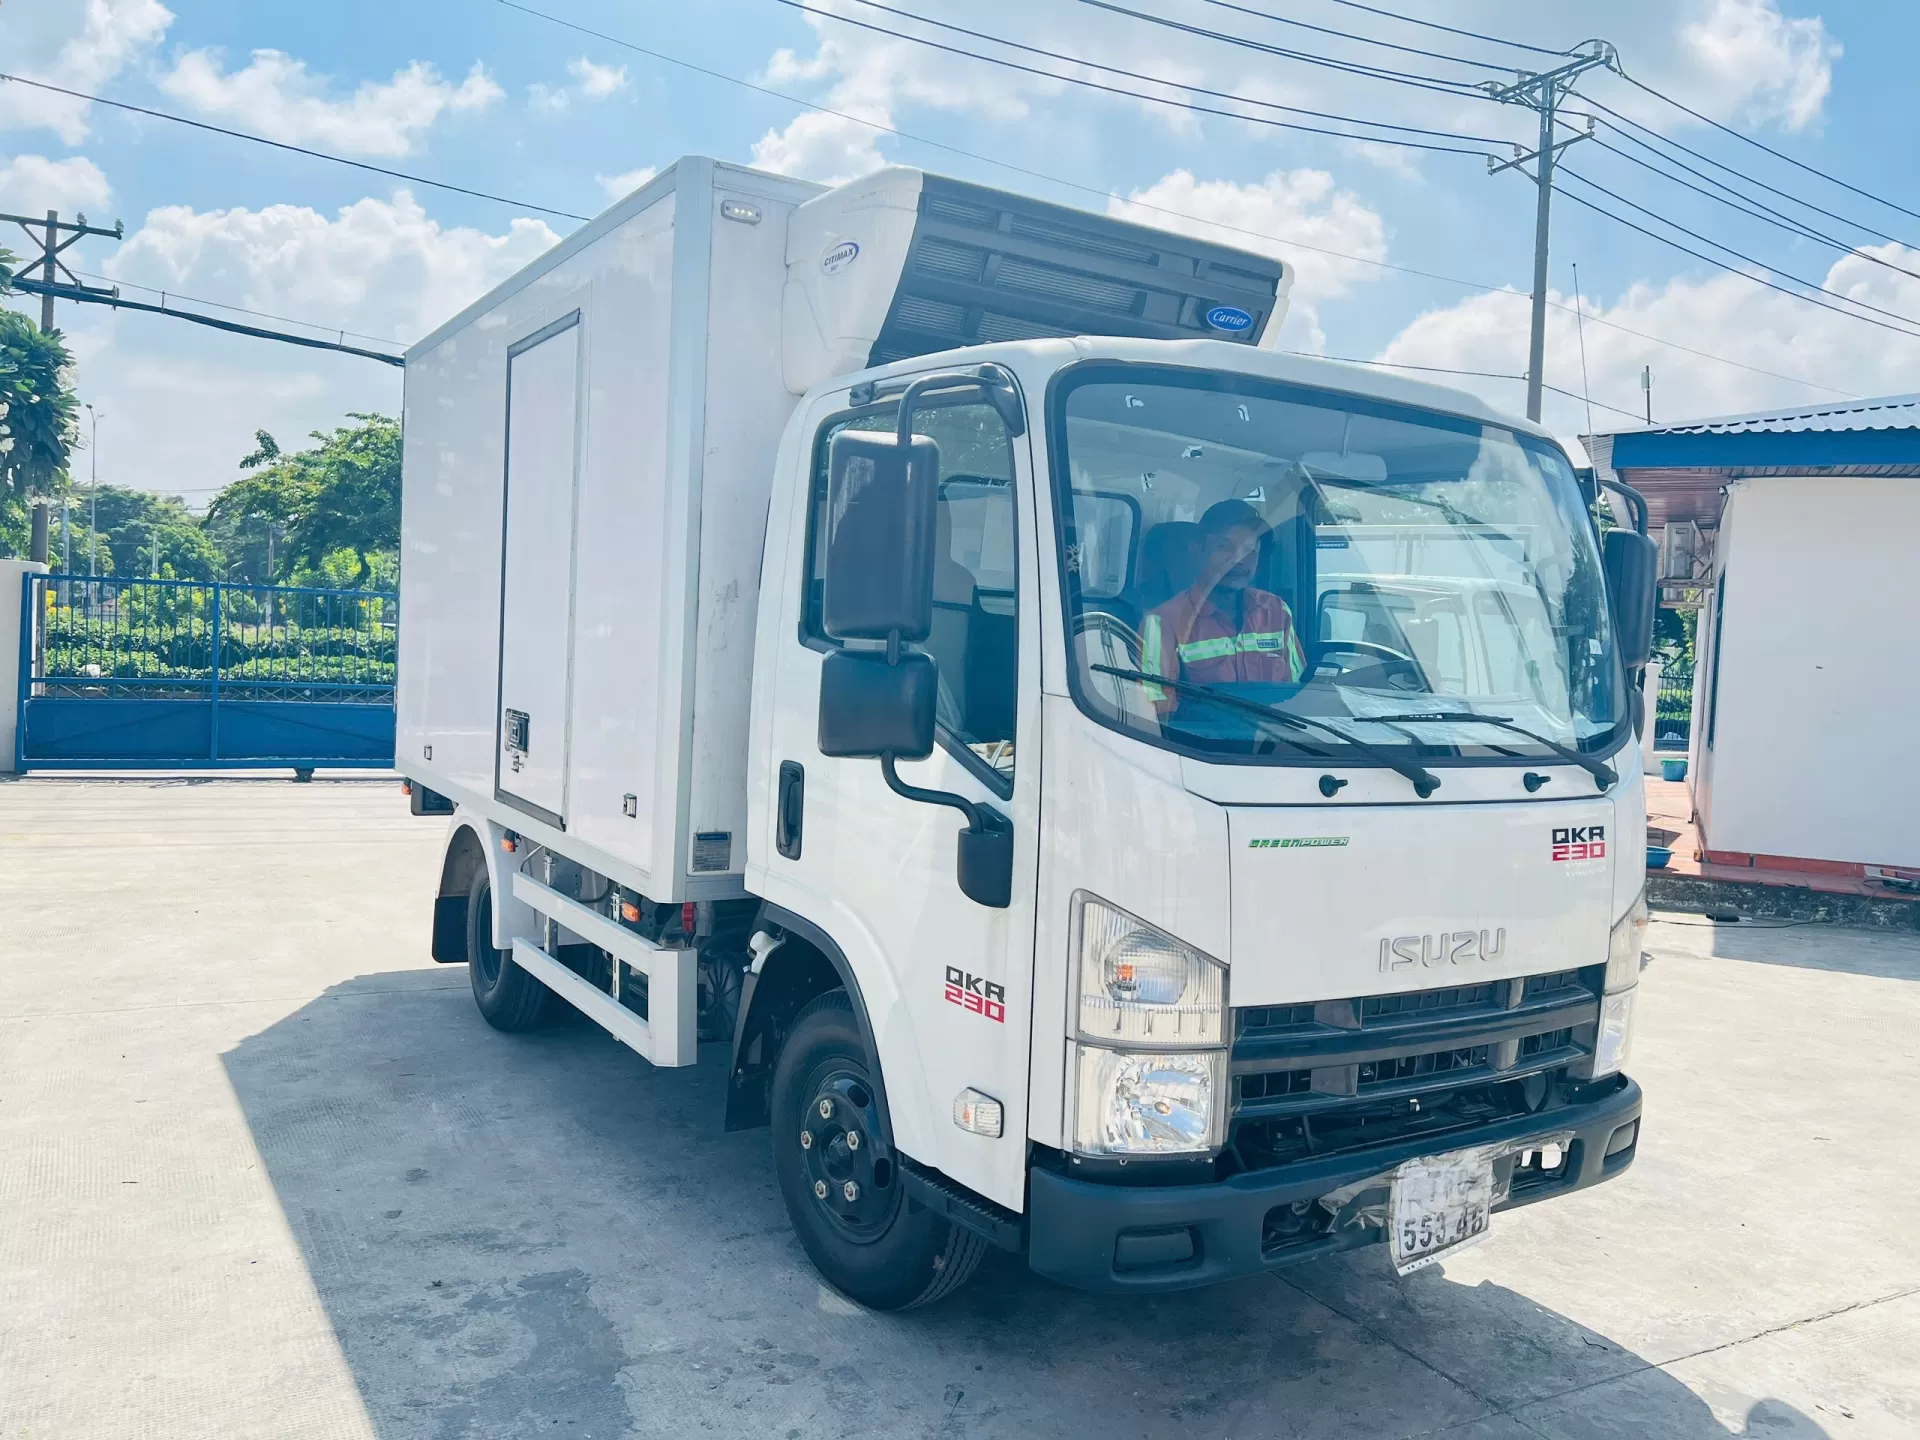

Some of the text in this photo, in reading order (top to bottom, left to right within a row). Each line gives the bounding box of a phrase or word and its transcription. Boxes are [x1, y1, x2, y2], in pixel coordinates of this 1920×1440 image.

[824, 247, 854, 267] CITIMAX
[1213, 311, 1248, 326] Carrier
[1552, 826, 1605, 844] QKR
[1552, 842, 1606, 861] 230
[1379, 928, 1506, 972] ISUZU
[945, 965, 1005, 1004] QKR
[945, 983, 1005, 1024] 230
